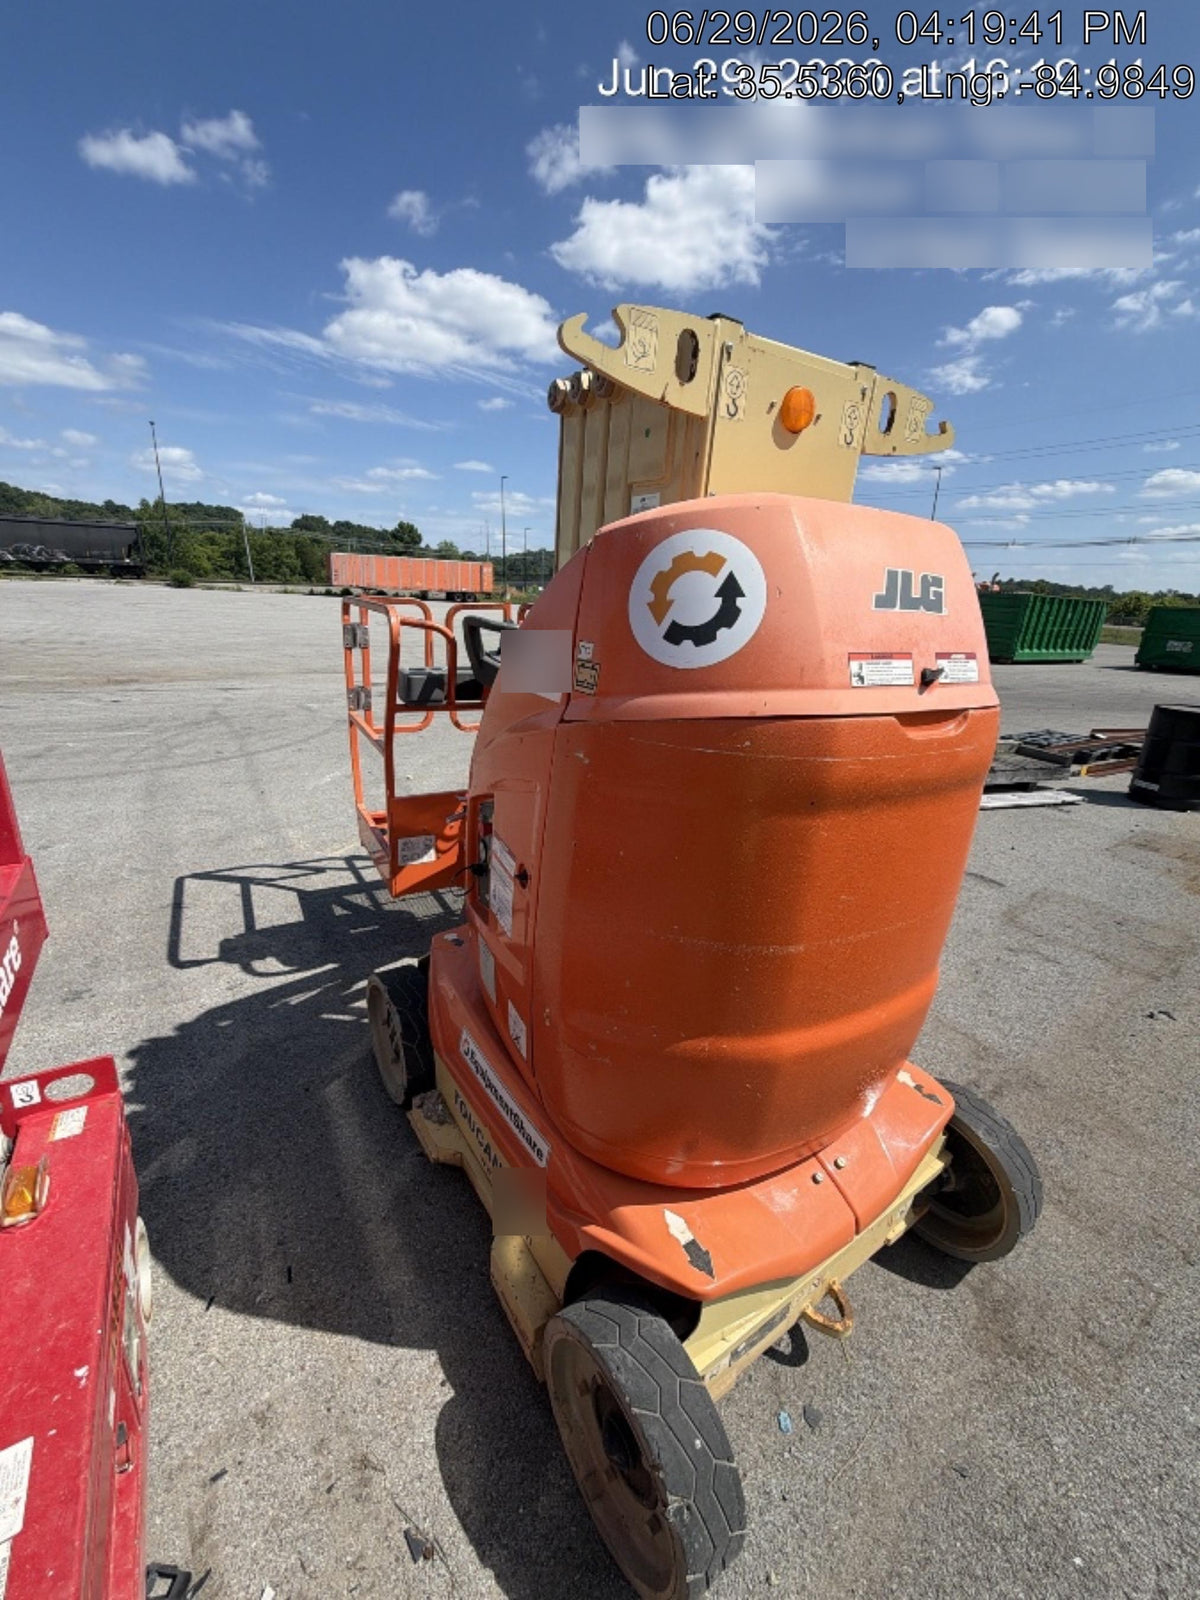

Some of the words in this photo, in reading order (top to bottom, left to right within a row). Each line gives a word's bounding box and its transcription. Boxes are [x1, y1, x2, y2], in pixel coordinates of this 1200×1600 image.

[872, 567, 945, 615] JLG
[0, 936, 22, 1018] are
[469, 1047, 544, 1162] EquipmentShare
